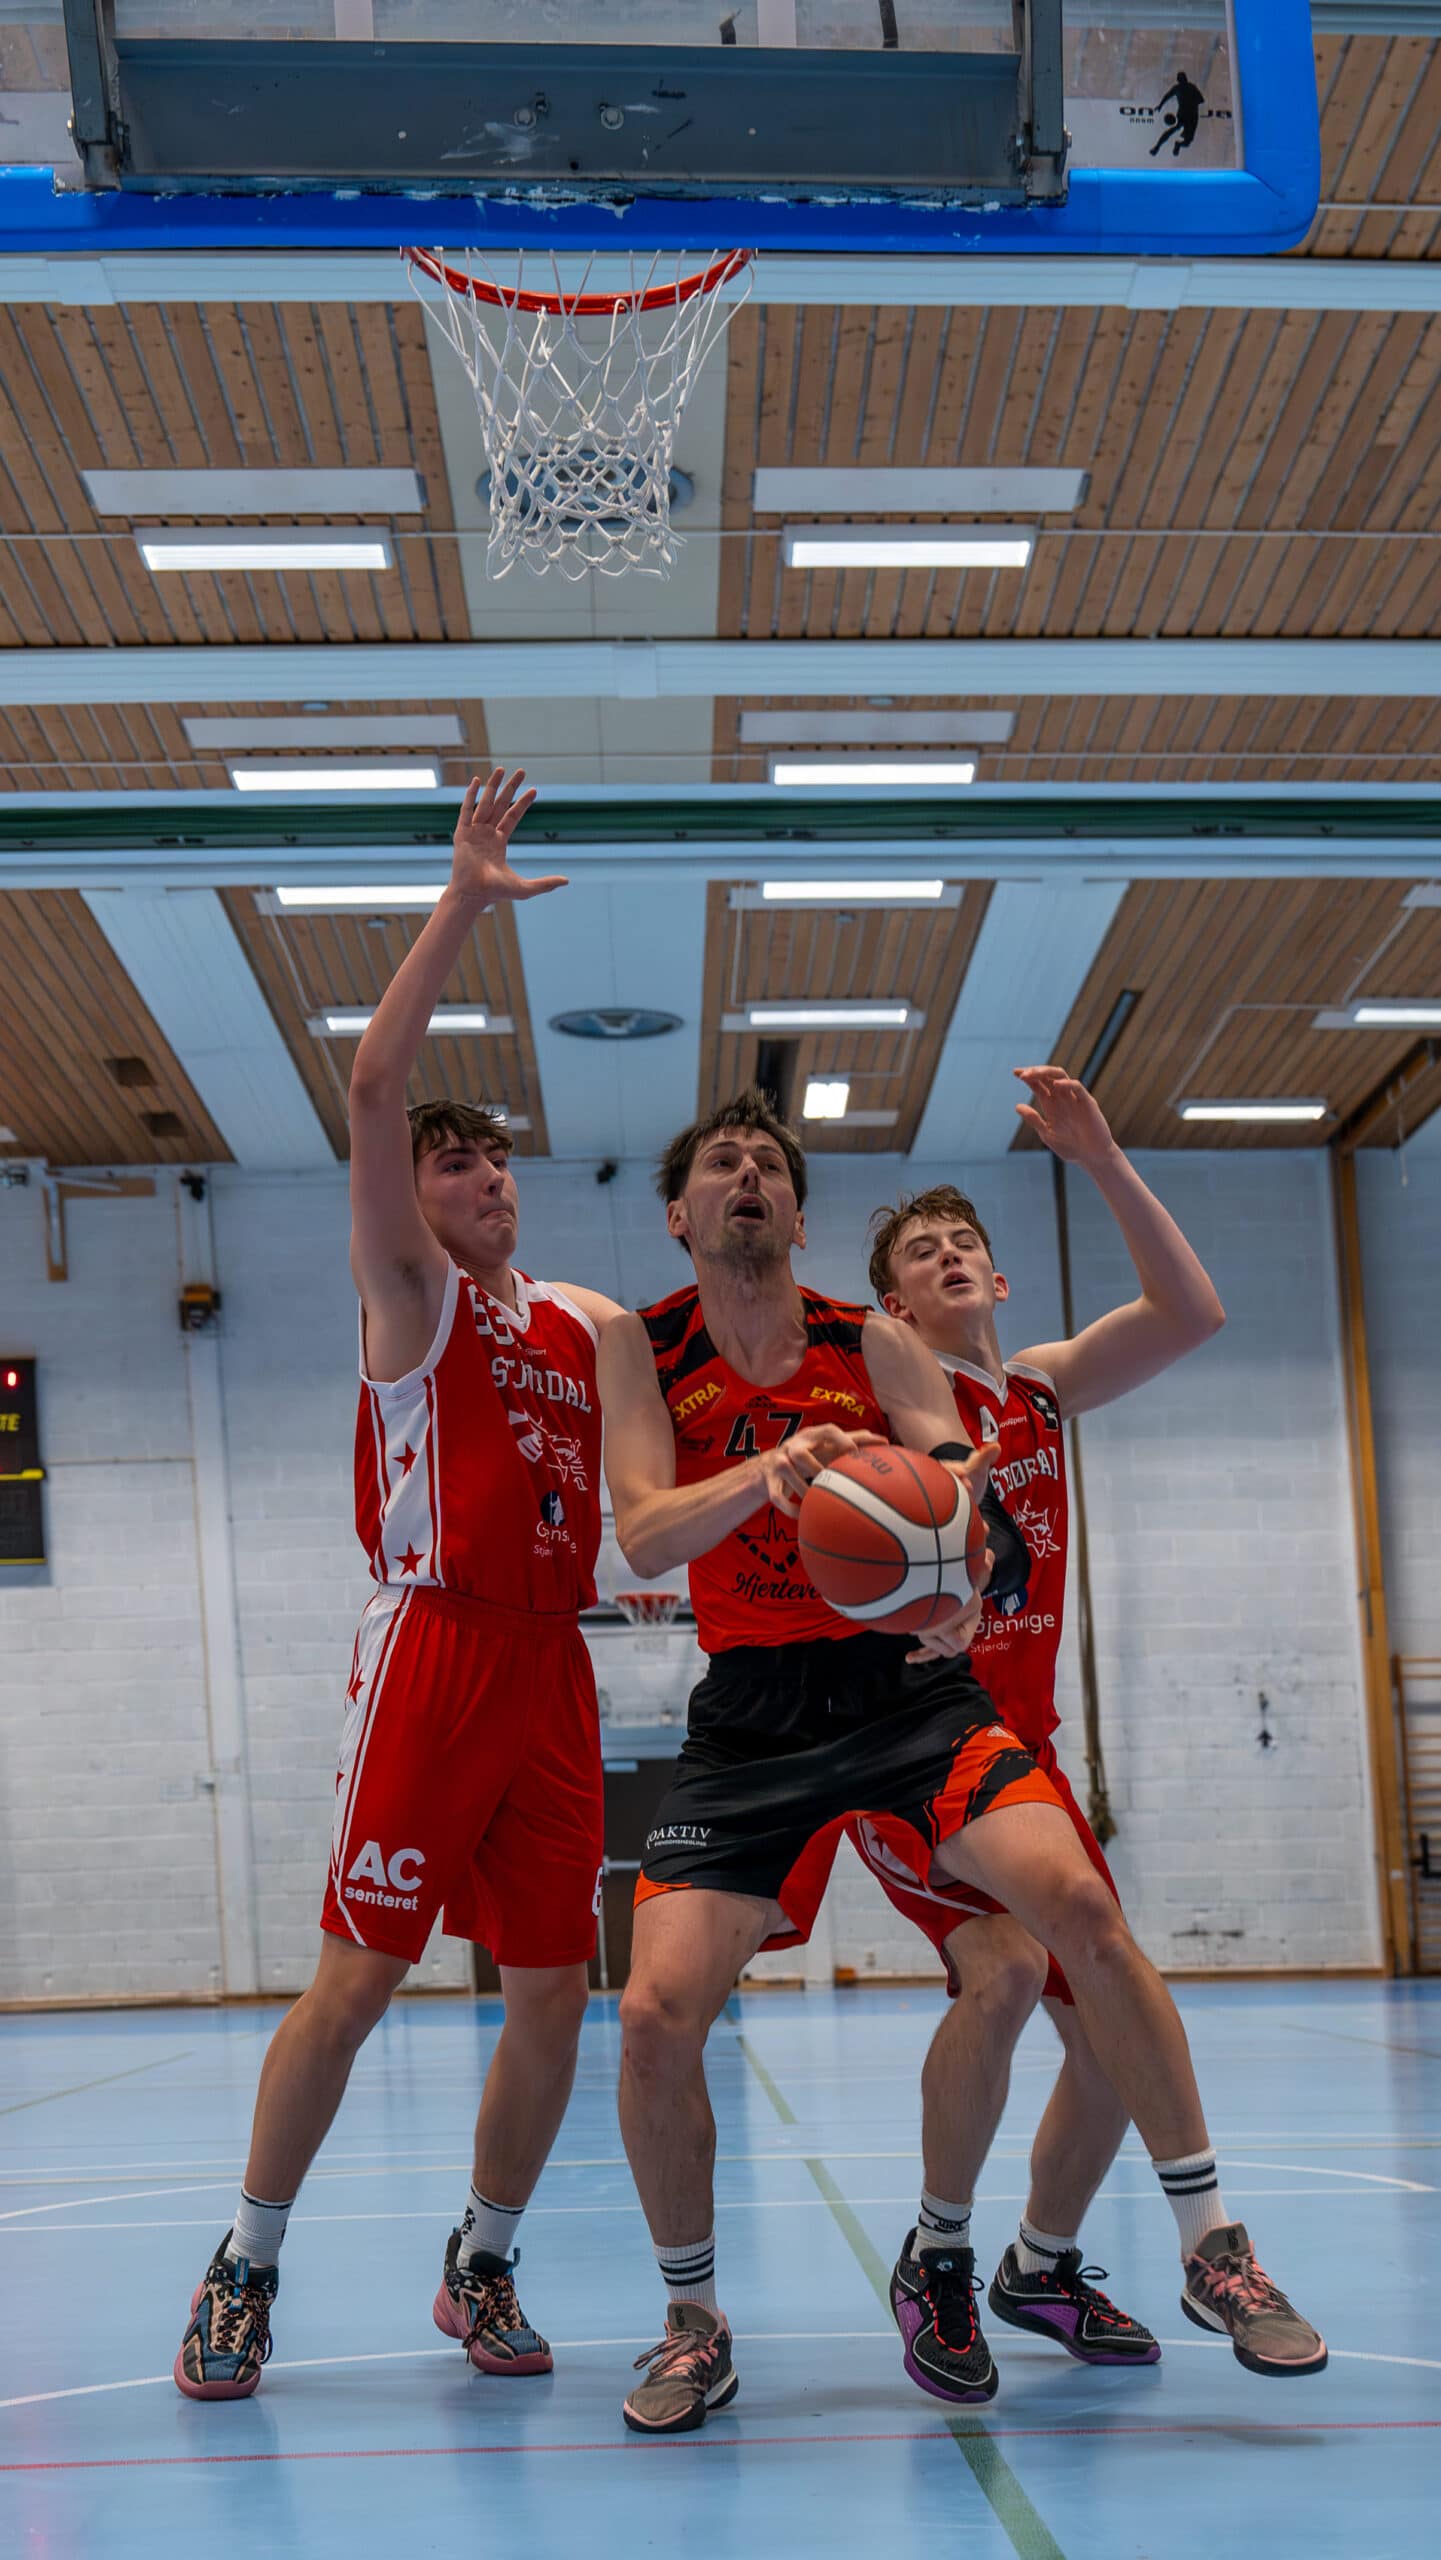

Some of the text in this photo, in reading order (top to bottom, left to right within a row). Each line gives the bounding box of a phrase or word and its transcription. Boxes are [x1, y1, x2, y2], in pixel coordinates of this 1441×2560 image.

[674, 1382, 722, 1421] XTRA
[810, 1386, 866, 1417] EXTRA
[723, 1411, 804, 1460] 47
[347, 1840, 426, 1891] AC
[344, 1885, 418, 1911] senteret
